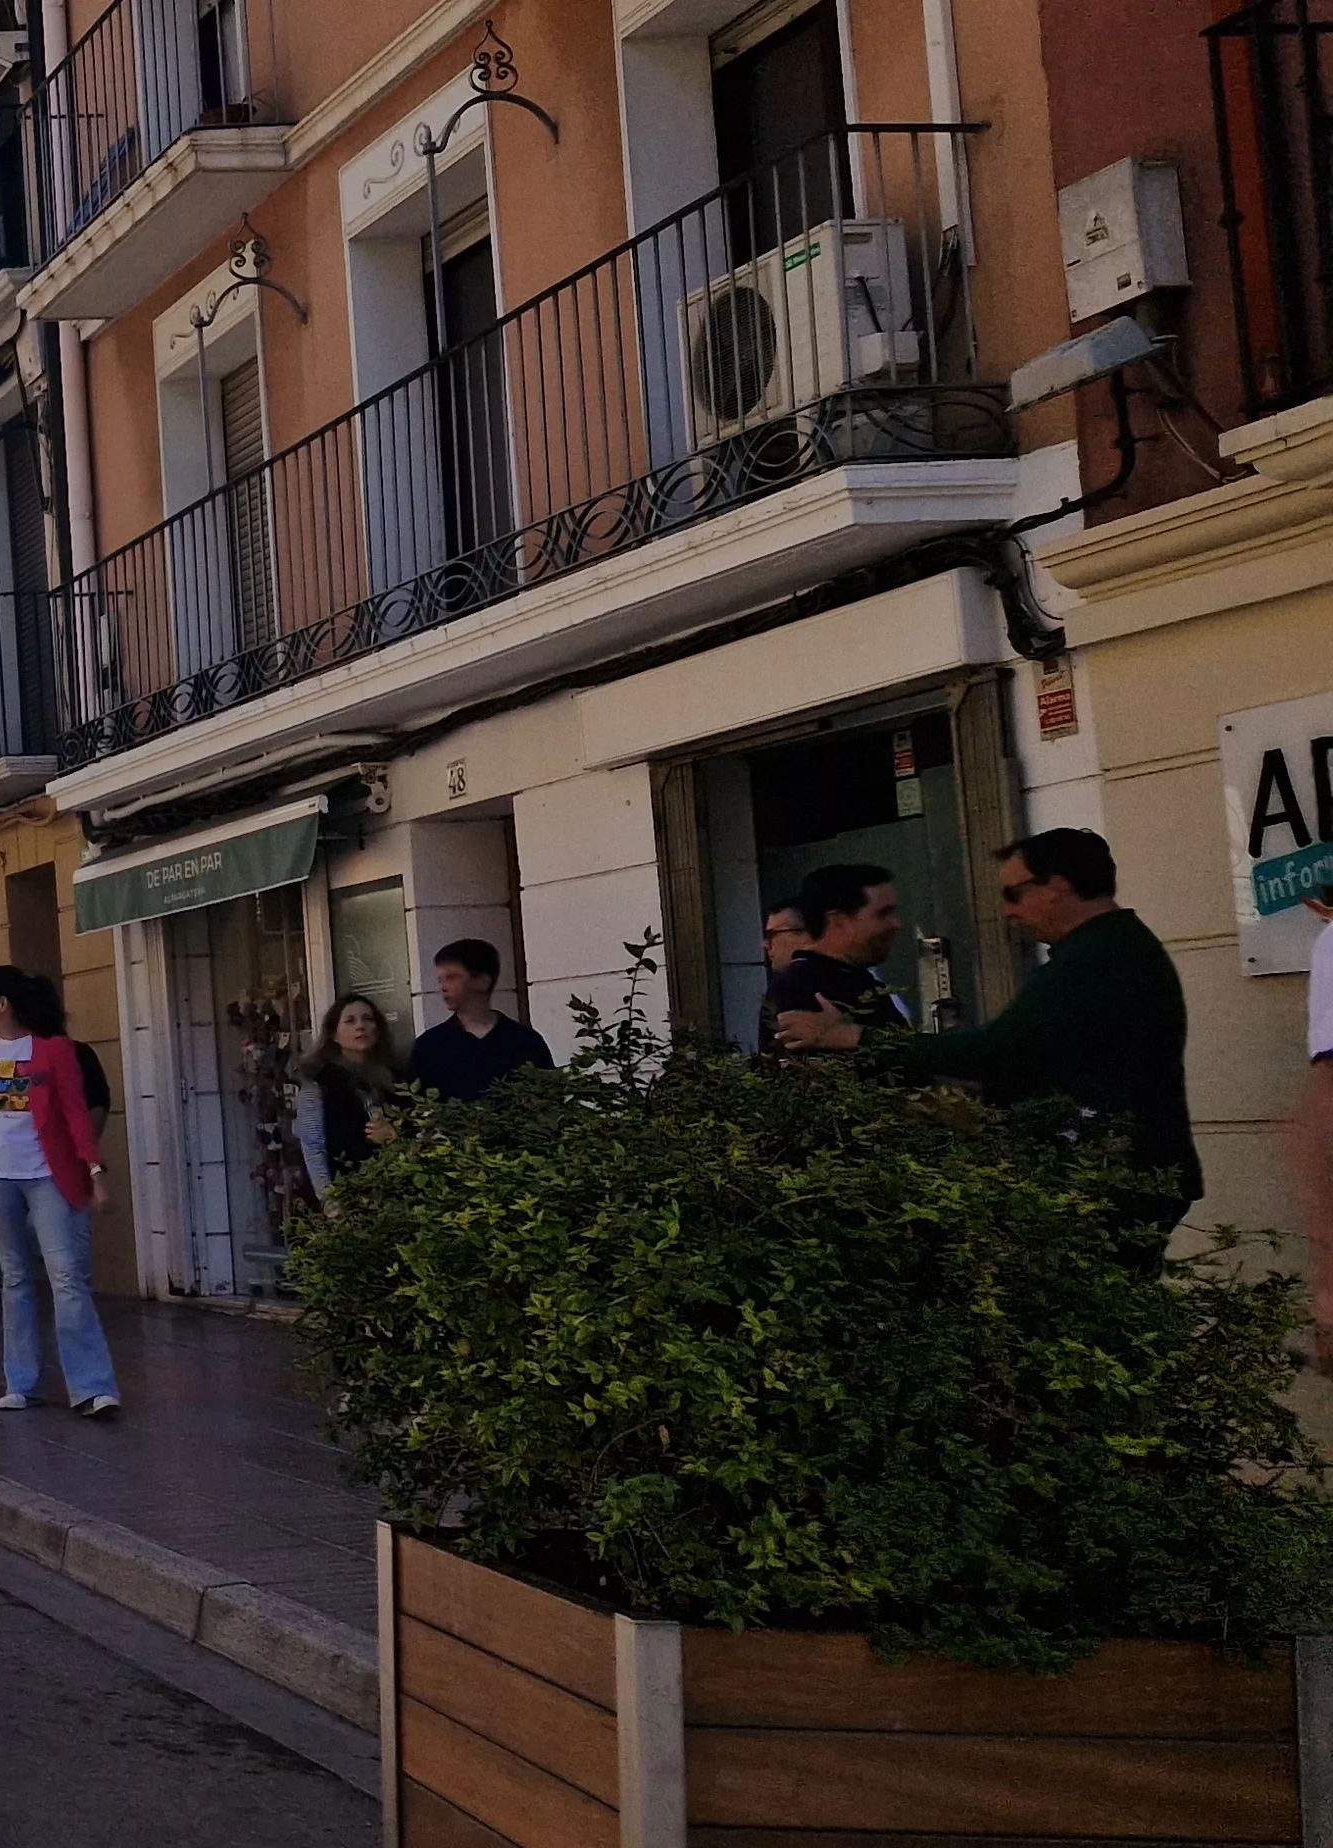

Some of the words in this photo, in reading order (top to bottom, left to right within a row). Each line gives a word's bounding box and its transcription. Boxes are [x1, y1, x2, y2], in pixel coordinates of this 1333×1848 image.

[448, 767, 466, 794] 48
[146, 870, 160, 889] DE
[162, 863, 183, 884] PAR
[184, 859, 199, 879] EN
[200, 852, 223, 873] PAR
